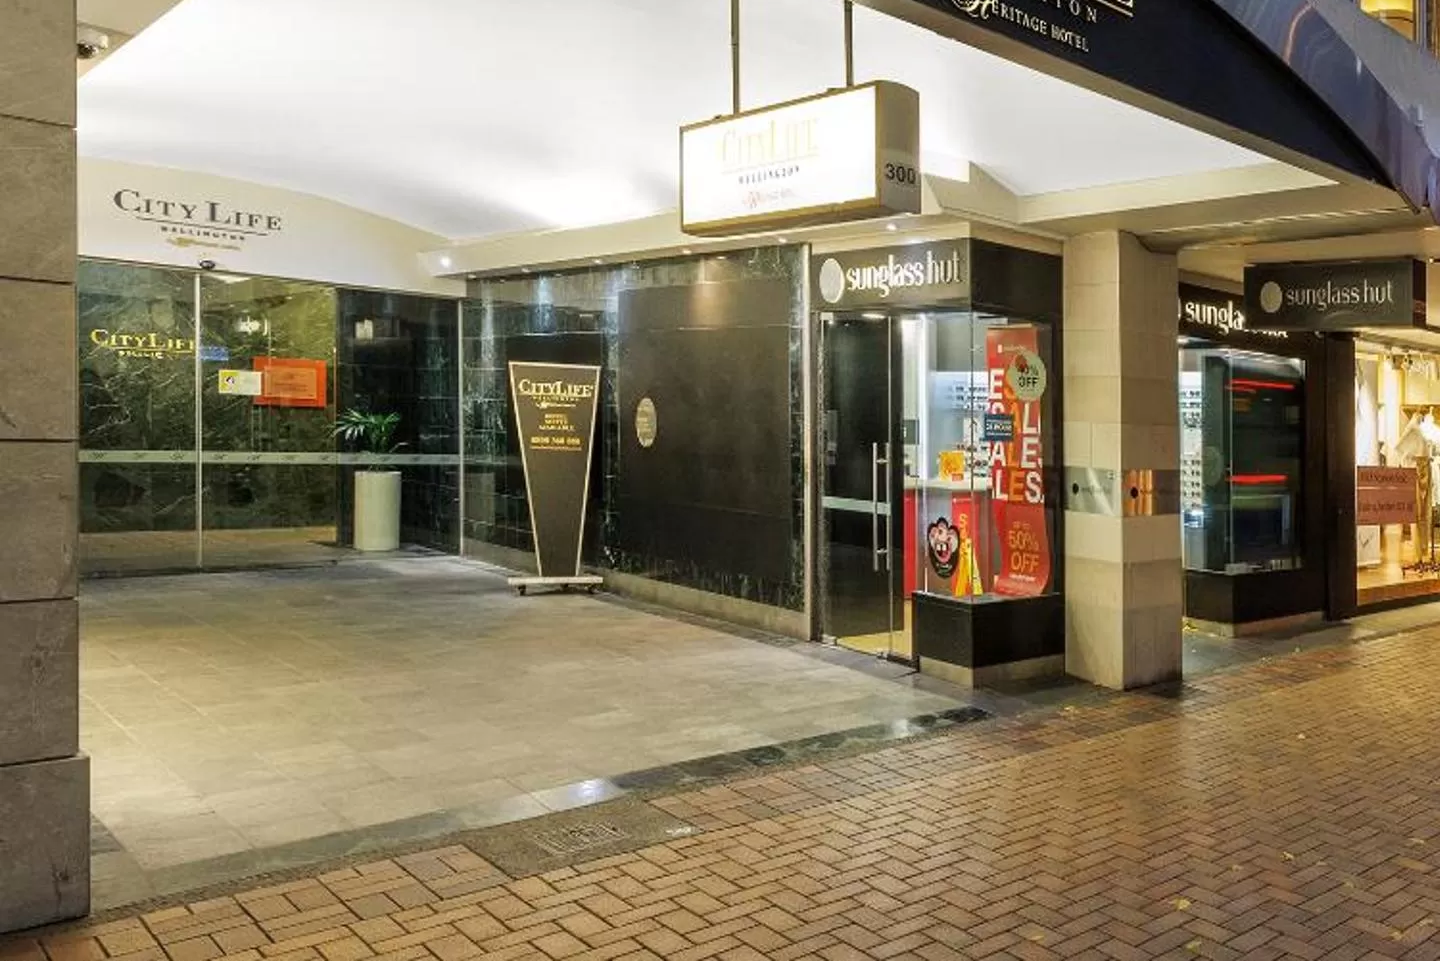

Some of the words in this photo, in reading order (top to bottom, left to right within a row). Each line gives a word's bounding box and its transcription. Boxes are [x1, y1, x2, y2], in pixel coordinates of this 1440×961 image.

[1051, 23, 1089, 52] HOTEL
[884, 162, 917, 185] 300
[846, 254, 925, 298] sunglass
[926, 249, 964, 285] hut
[1286, 280, 1360, 311] sunglass
[1363, 279, 1394, 305] hut
[1185, 300, 1250, 335] sungla
[1018, 377, 1040, 388] OFF
[1008, 531, 1039, 552] 50%
[1011, 552, 1040, 574] OFF
